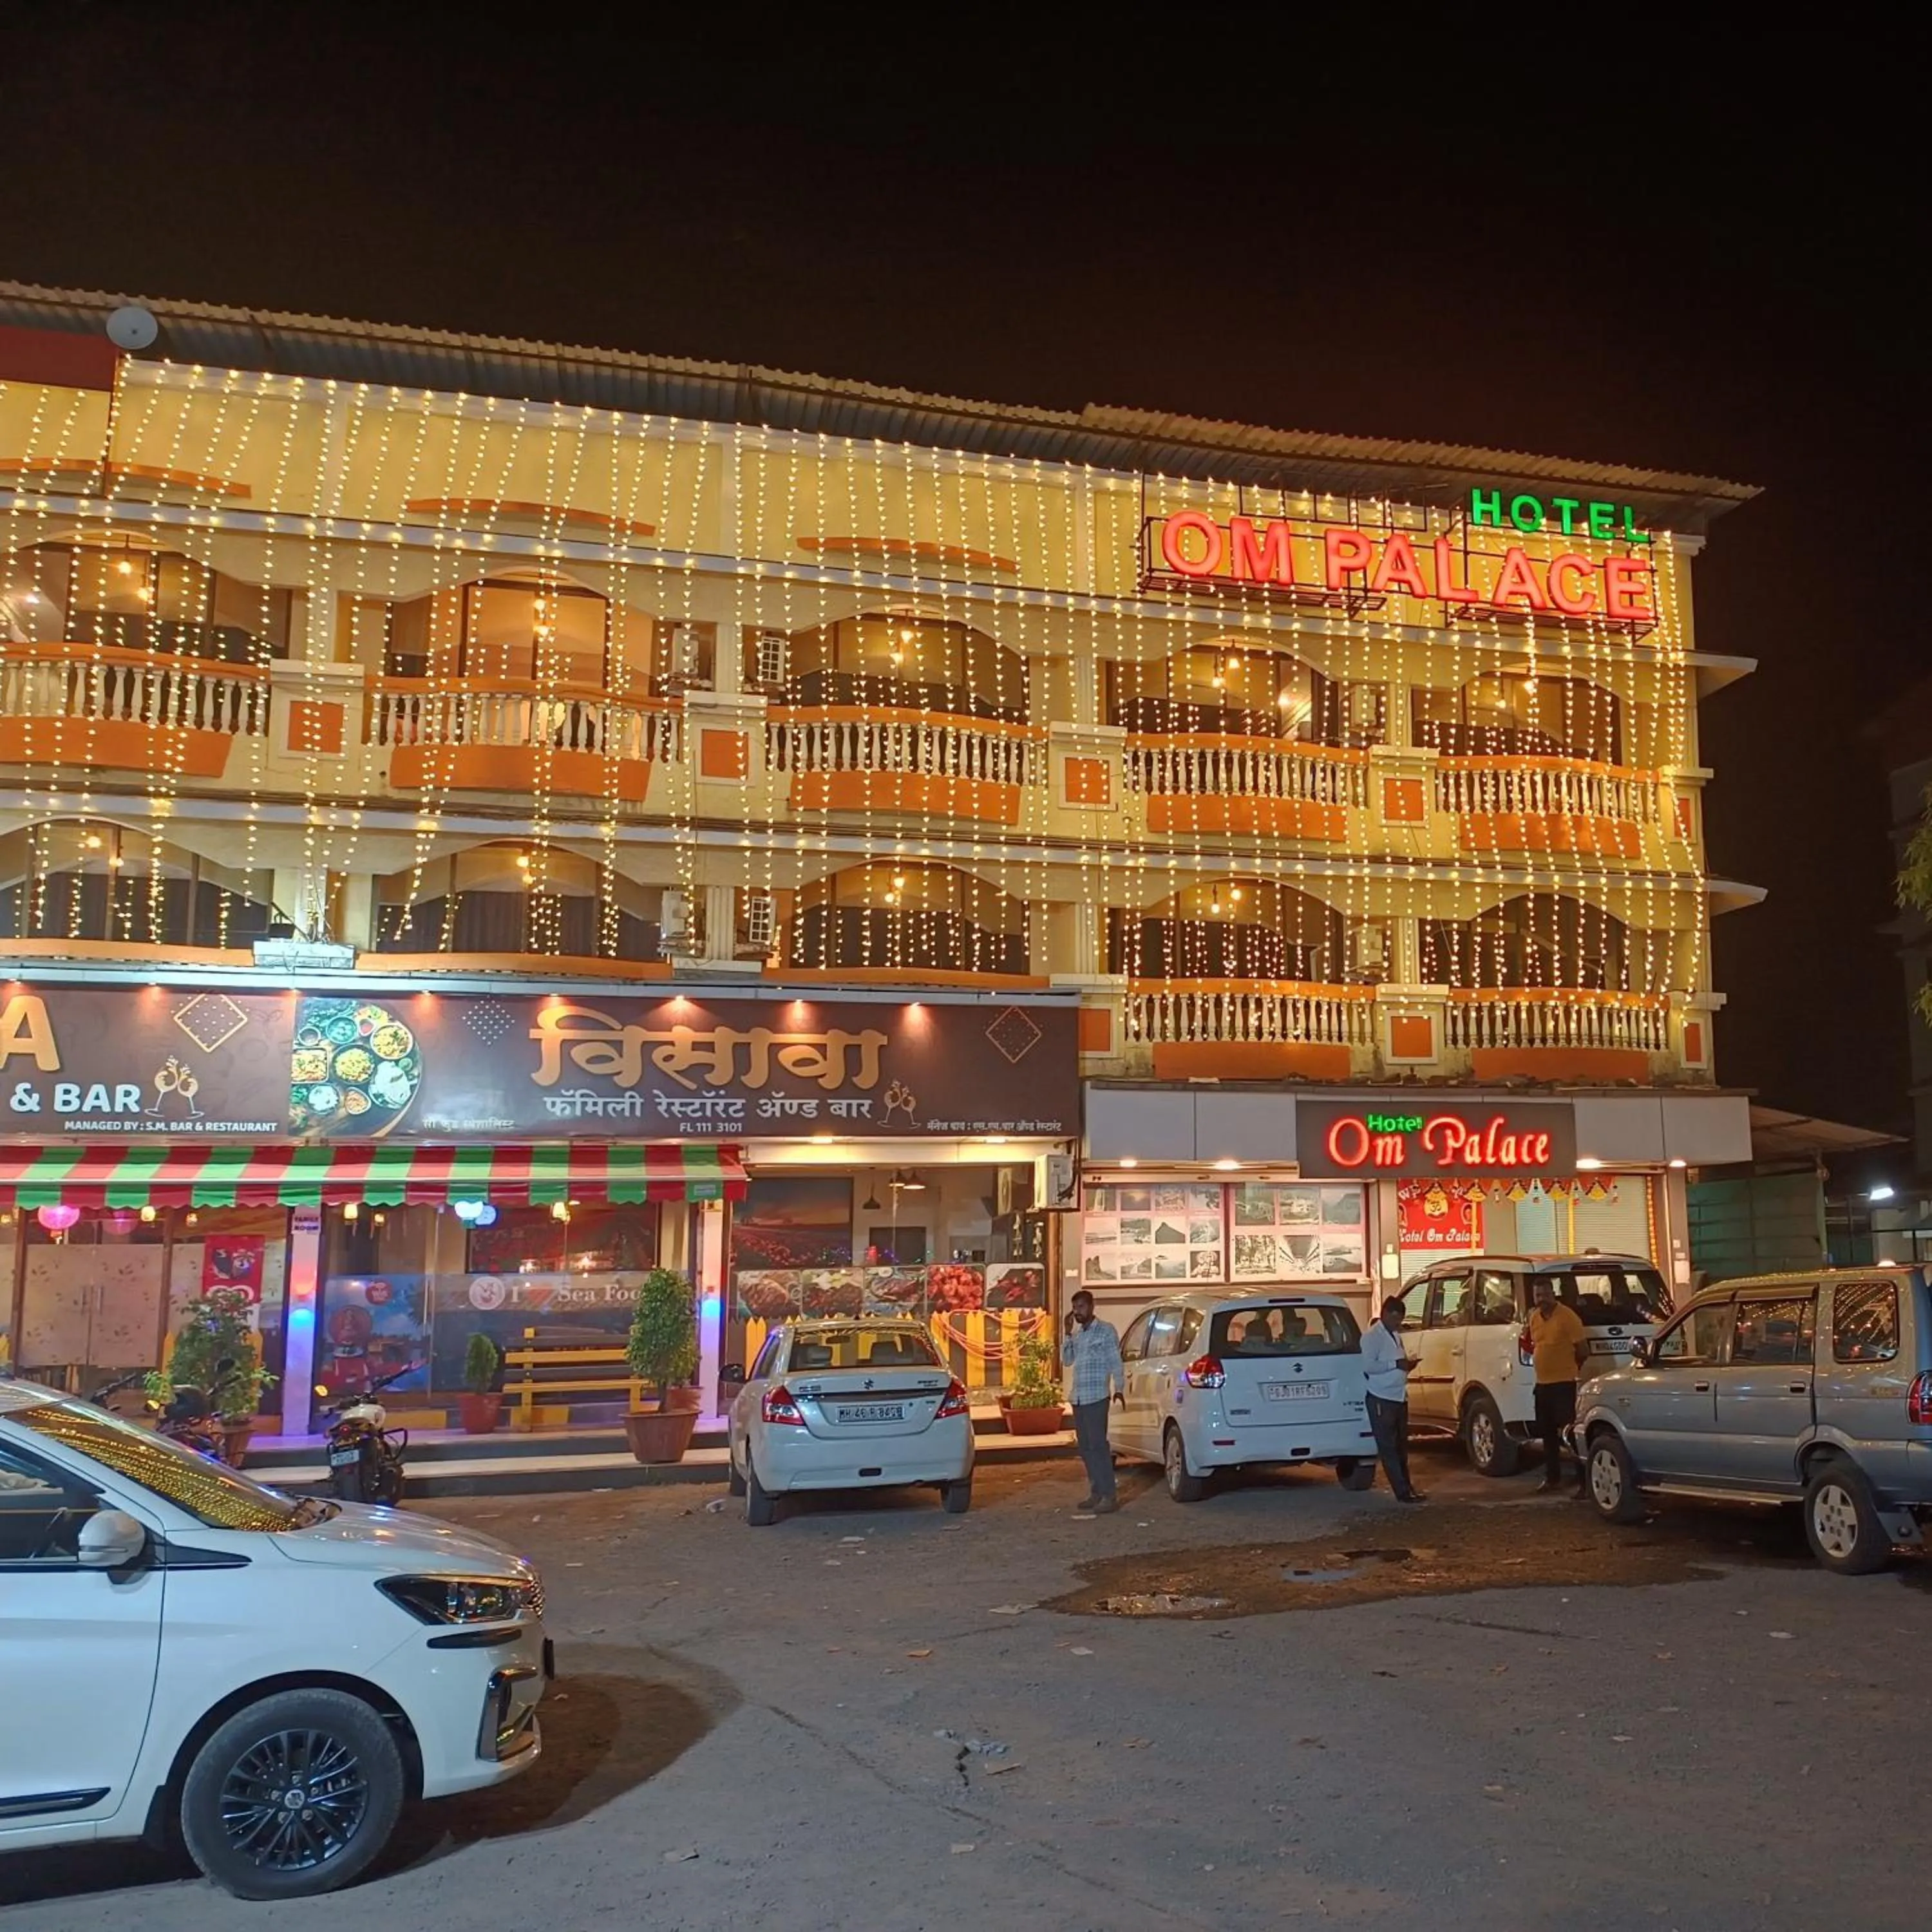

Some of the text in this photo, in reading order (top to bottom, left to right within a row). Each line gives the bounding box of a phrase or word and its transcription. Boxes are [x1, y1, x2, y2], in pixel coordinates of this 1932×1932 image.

[1471, 488, 1649, 543] HOTEL
[1162, 510, 1654, 620] OM PALACE
[529, 1005, 888, 1090] विसावा
[10, 1082, 141, 1113] & BAR
[652, 1089, 746, 1118] रेस्टॉरंट
[827, 1099, 874, 1119] बार
[64, 1121, 121, 1131] MANAGED
[170, 1122, 193, 1132] BAR
[194, 1122, 203, 1132] &
[205, 1122, 278, 1132] RESTAURANT
[716, 1122, 743, 1133] 3101
[1367, 1114, 1423, 1132] Hotel
[1329, 1117, 1549, 1166] Om Palace
[557, 1283, 595, 1302] Sea
[603, 1283, 642, 1302] Foo
